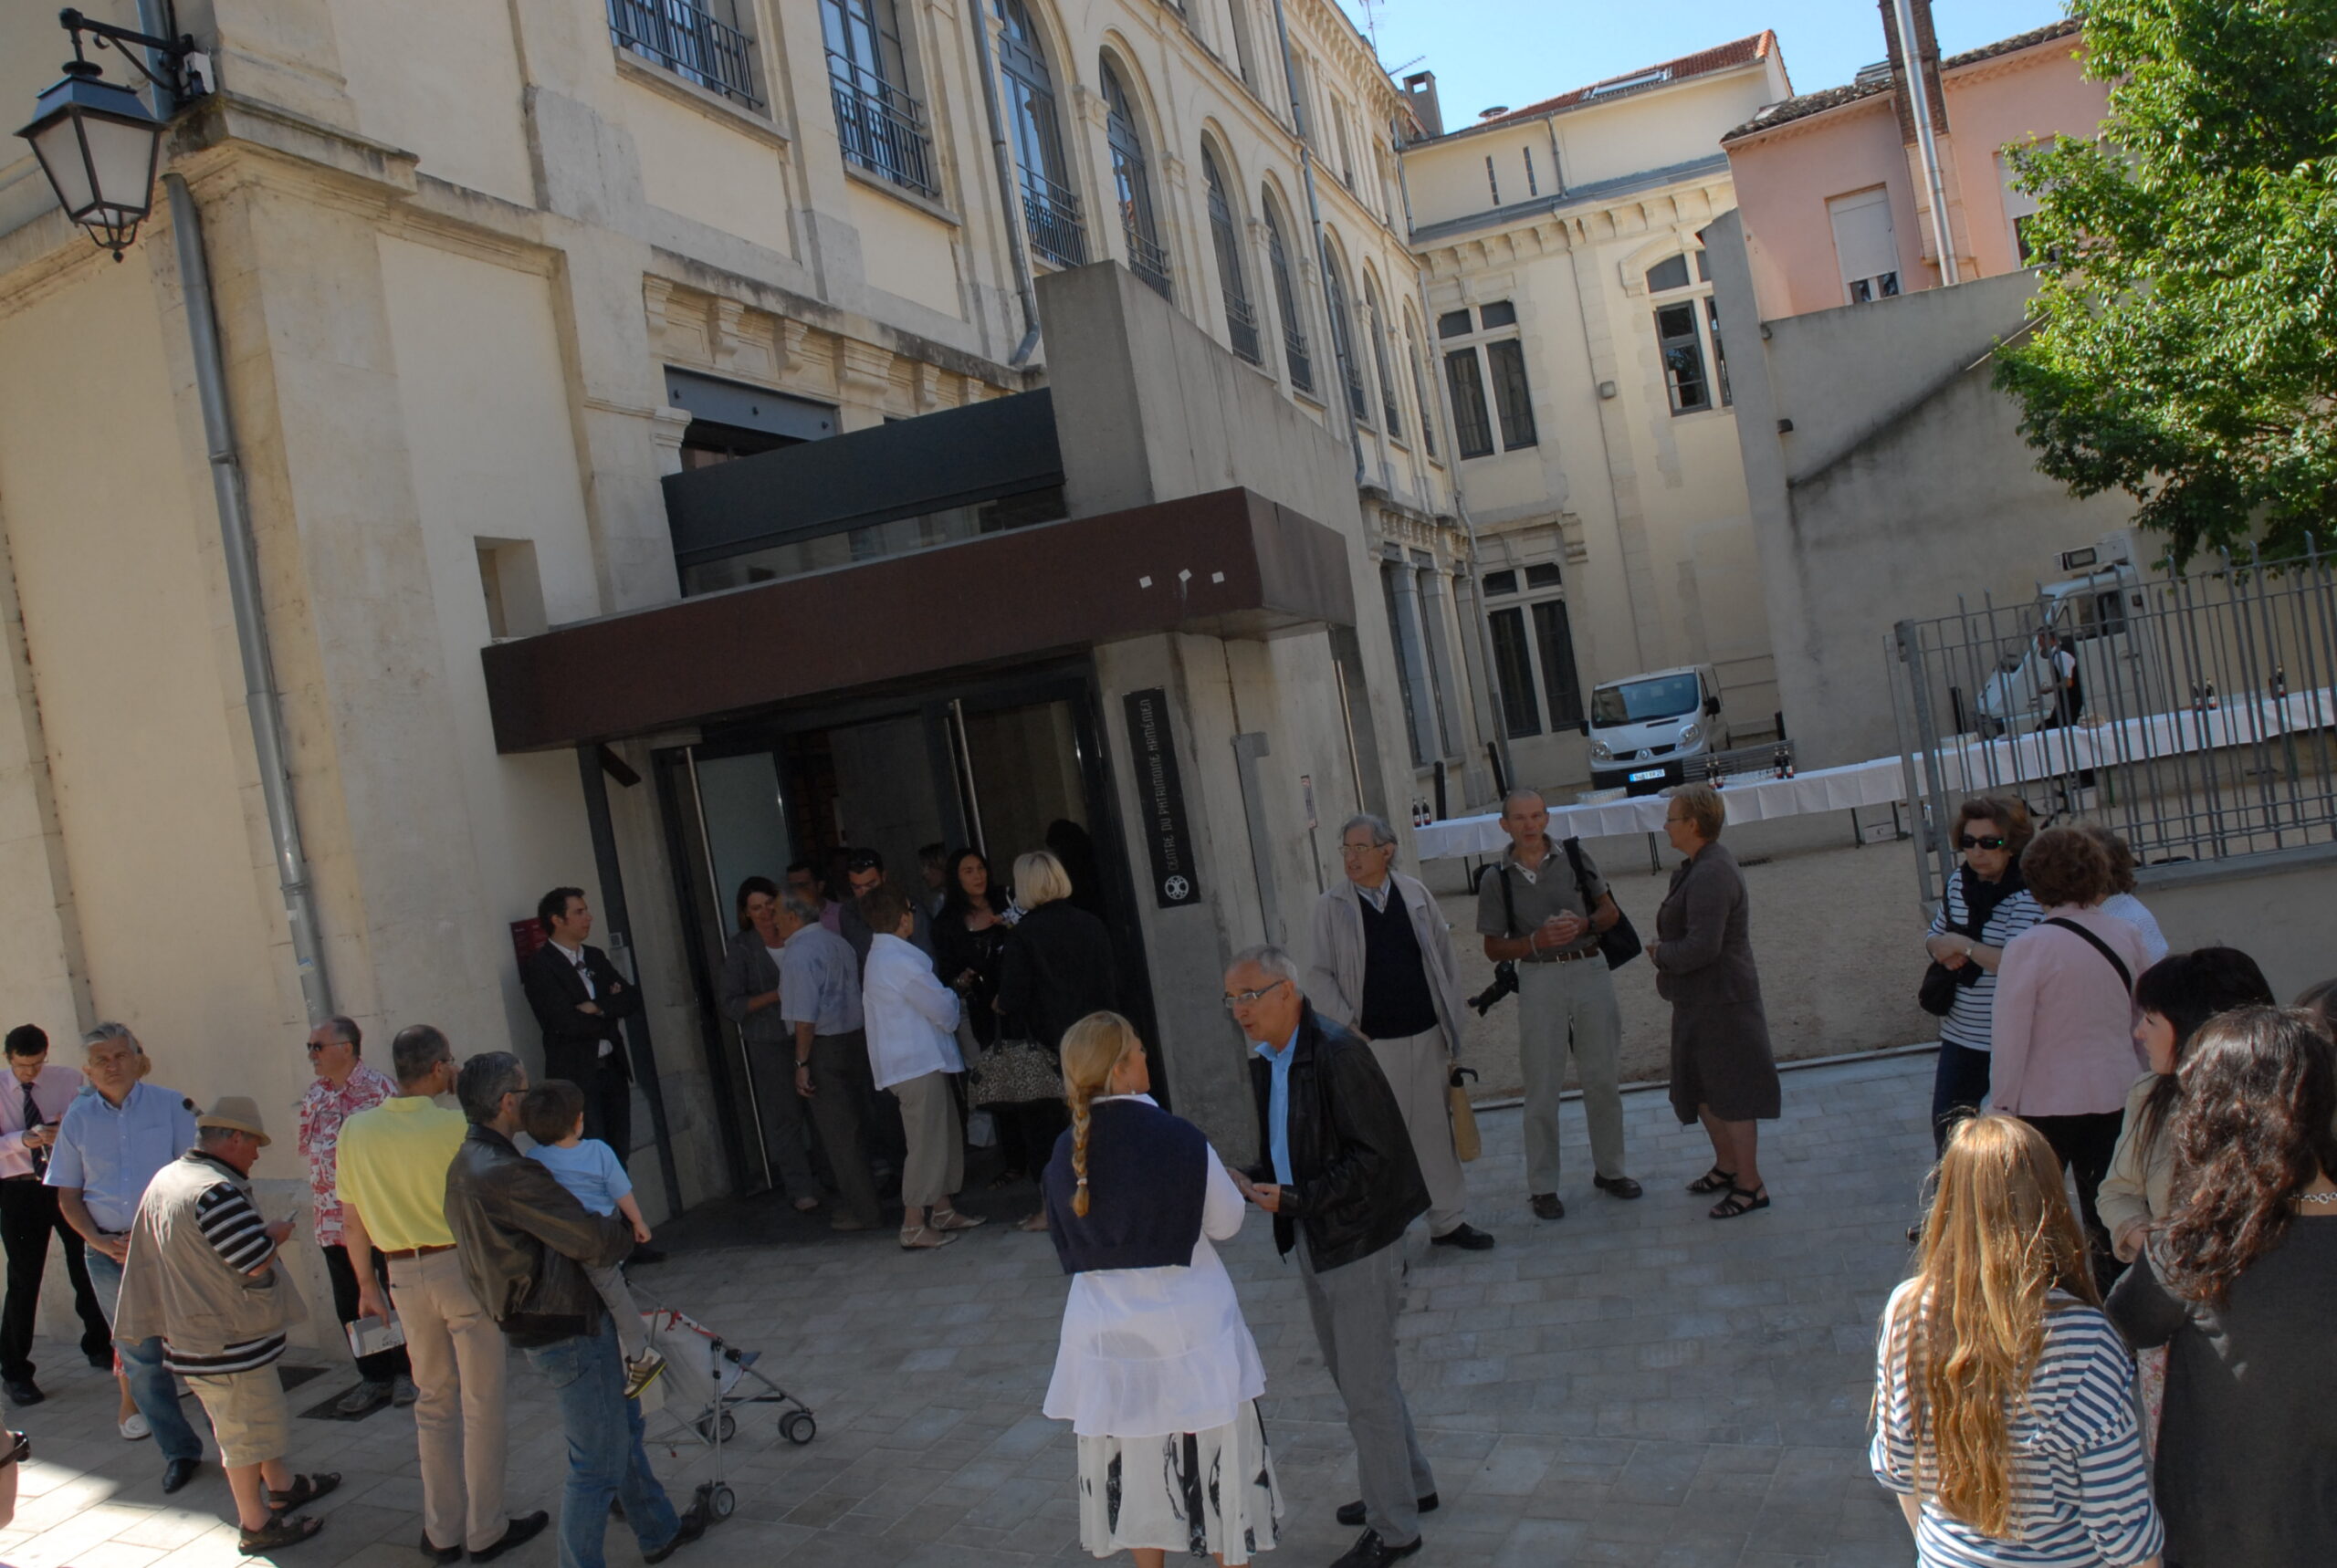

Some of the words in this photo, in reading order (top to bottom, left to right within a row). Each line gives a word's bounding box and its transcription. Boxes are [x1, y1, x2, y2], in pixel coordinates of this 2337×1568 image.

[1149, 754, 1170, 815] PATRIMOINE
[1161, 817, 1173, 831] DU
[1163, 834, 1179, 871] CENTRE
